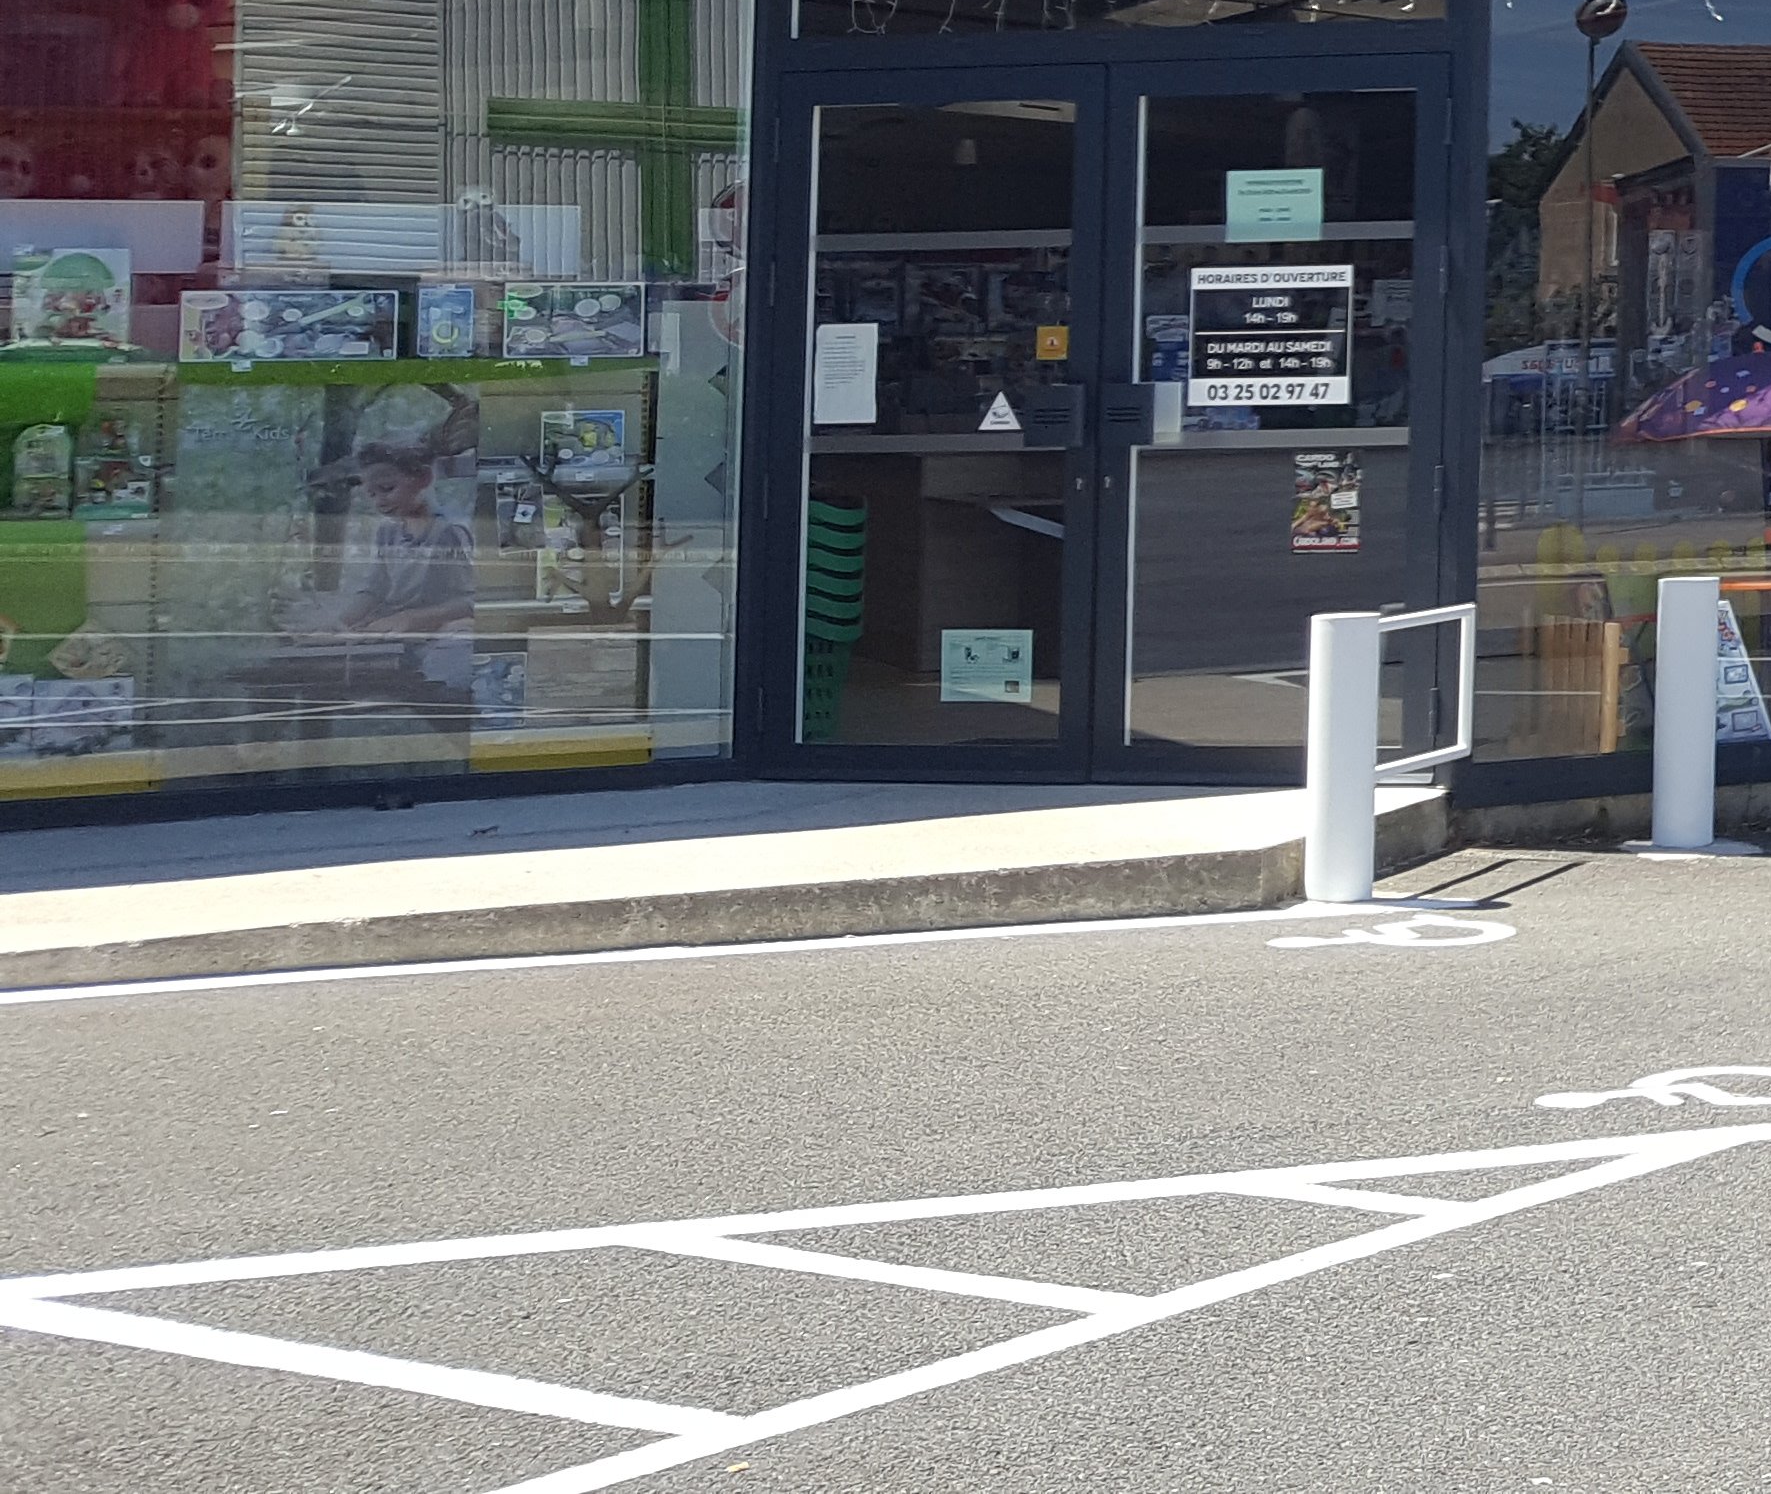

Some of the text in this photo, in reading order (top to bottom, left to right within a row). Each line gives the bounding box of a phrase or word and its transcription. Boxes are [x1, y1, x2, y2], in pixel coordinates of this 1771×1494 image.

[1197, 274, 1257, 284] HORAIRES
[1252, 296, 1290, 308] LUNDI
[1244, 312, 1266, 324] 14h
[1207, 341, 1332, 354] DU MARDI AU SAMEDI
[1206, 358, 1222, 370] 9h
[1259, 358, 1274, 369] et
[1207, 382, 1330, 401] 03 25 02 97 47
